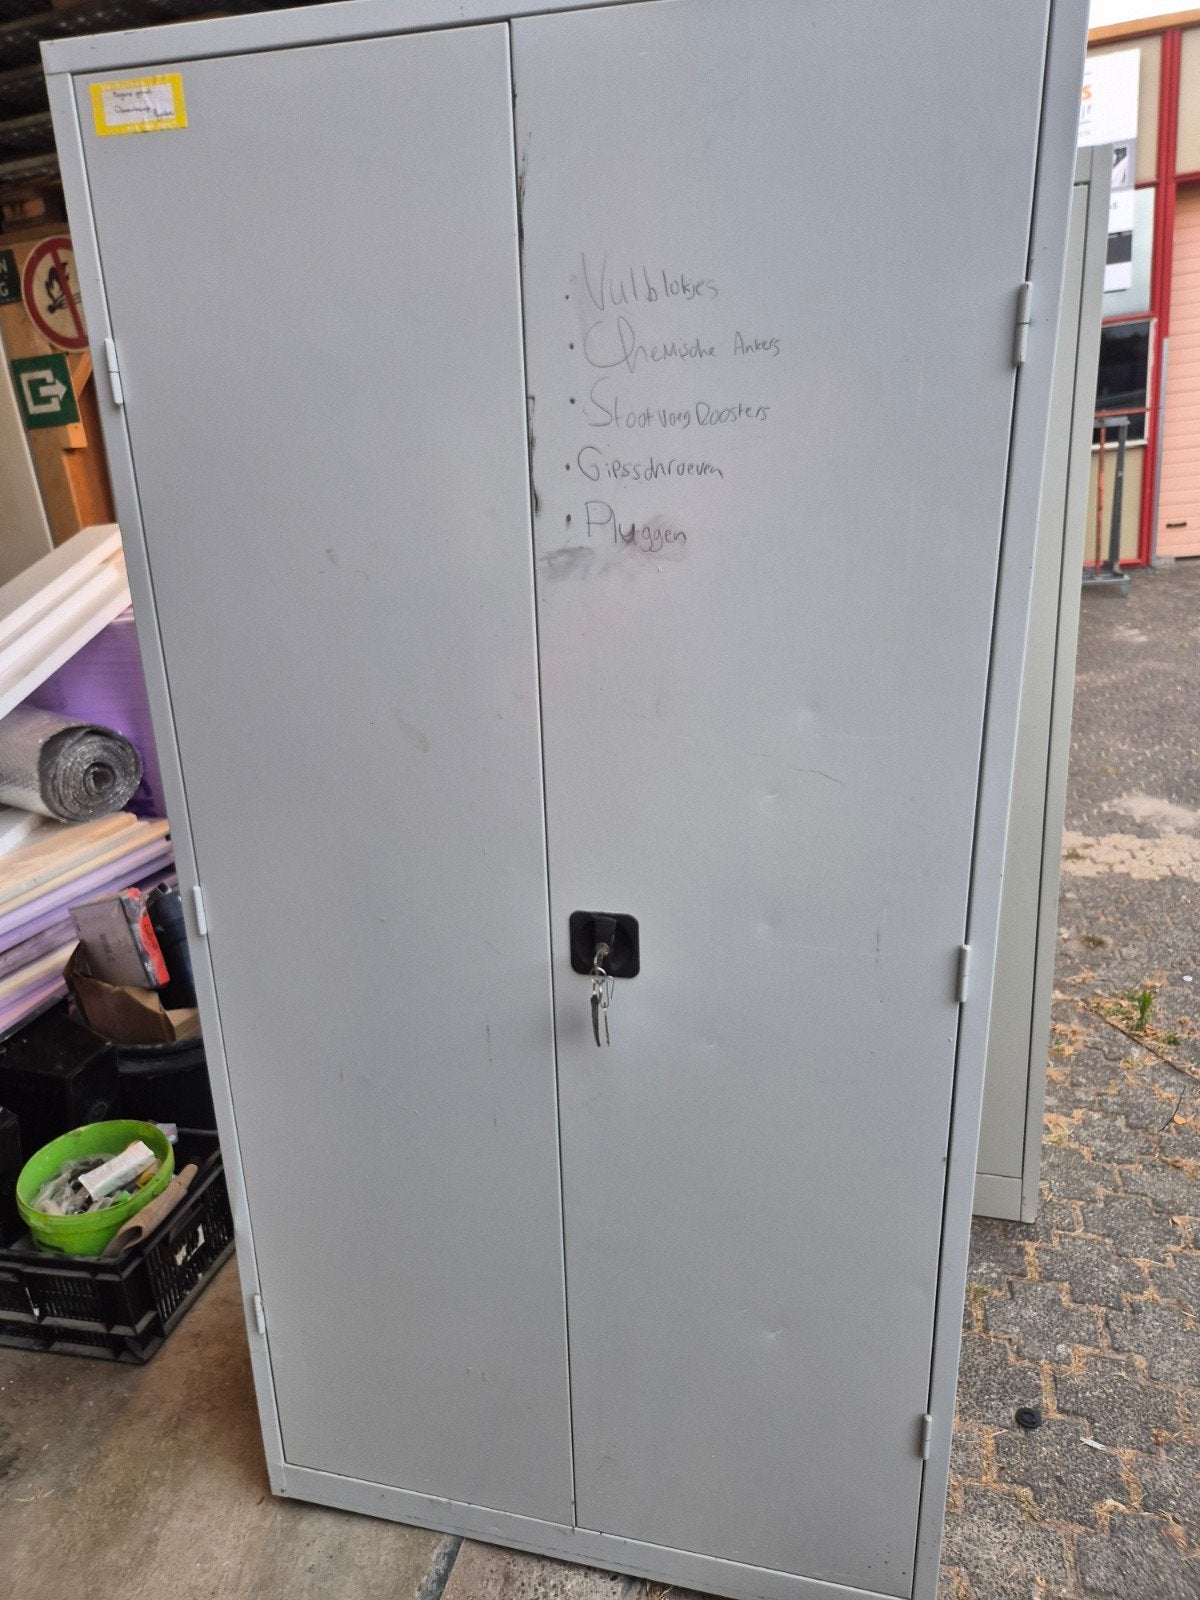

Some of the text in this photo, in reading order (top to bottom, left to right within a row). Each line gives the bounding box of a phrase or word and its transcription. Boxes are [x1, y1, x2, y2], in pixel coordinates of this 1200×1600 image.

[580, 252, 719, 311] Vulblokjes
[733, 331, 781, 357] Ankers
[584, 500, 688, 553] Pluggen
